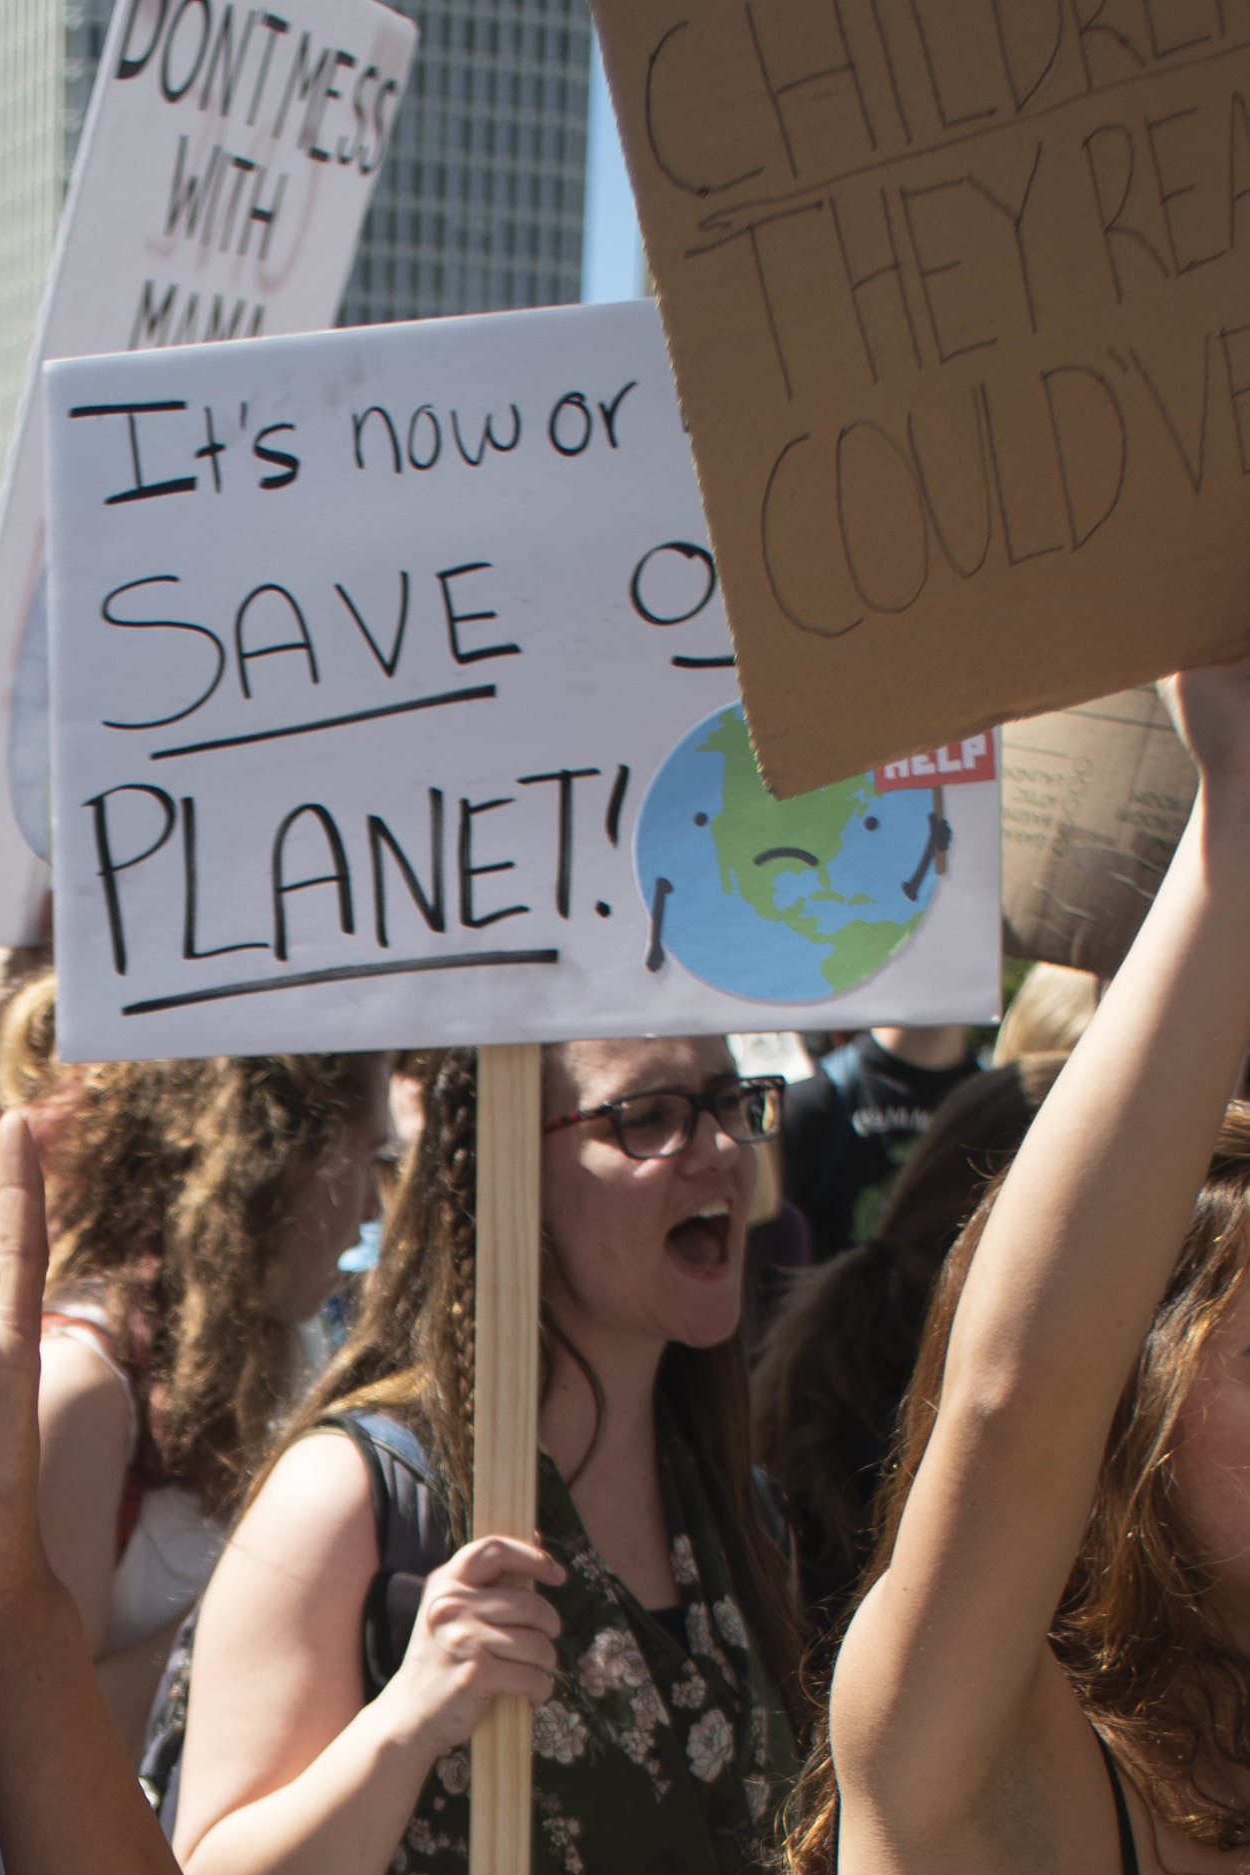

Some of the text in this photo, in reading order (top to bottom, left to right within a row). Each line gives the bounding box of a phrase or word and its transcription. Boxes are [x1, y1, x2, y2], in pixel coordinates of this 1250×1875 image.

[269, 30, 397, 176] MESS
[164, 133, 291, 262] WITH
[684, 140, 1042, 402] THEY
[68, 380, 640, 505] It's now or
[100, 561, 524, 731] SAVE
[80, 764, 632, 976] PLANET!
